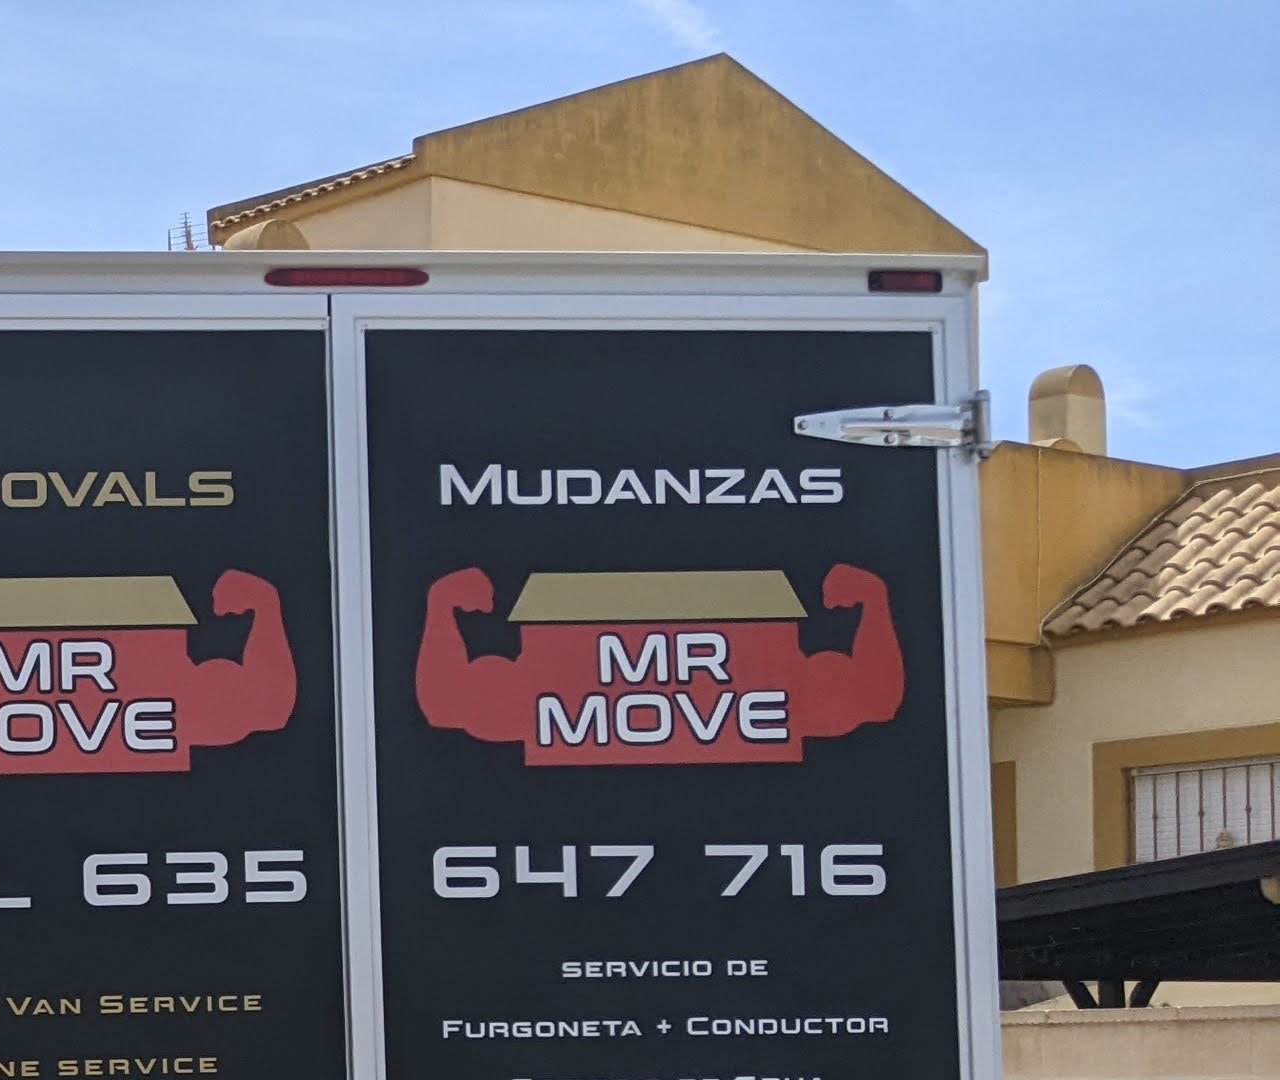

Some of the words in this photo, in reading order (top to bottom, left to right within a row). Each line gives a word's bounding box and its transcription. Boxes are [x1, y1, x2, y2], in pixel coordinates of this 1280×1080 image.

[441, 464, 843, 505] MUDANZAS
[599, 633, 729, 683] MR
[538, 691, 789, 745] MOVE
[83, 850, 307, 906] 635
[433, 845, 655, 898] 647
[705, 844, 886, 896] 716
[561, 960, 713, 978] SERVICIO
[726, 959, 769, 976] DE
[6, 997, 81, 1016] VAN
[99, 994, 262, 1014] SERVICE
[442, 1019, 643, 1039] FURGONETA
[656, 1019, 672, 1034] +
[686, 1016, 890, 1035] CONDUCTOR
[58, 1057, 218, 1077] SERVICE
